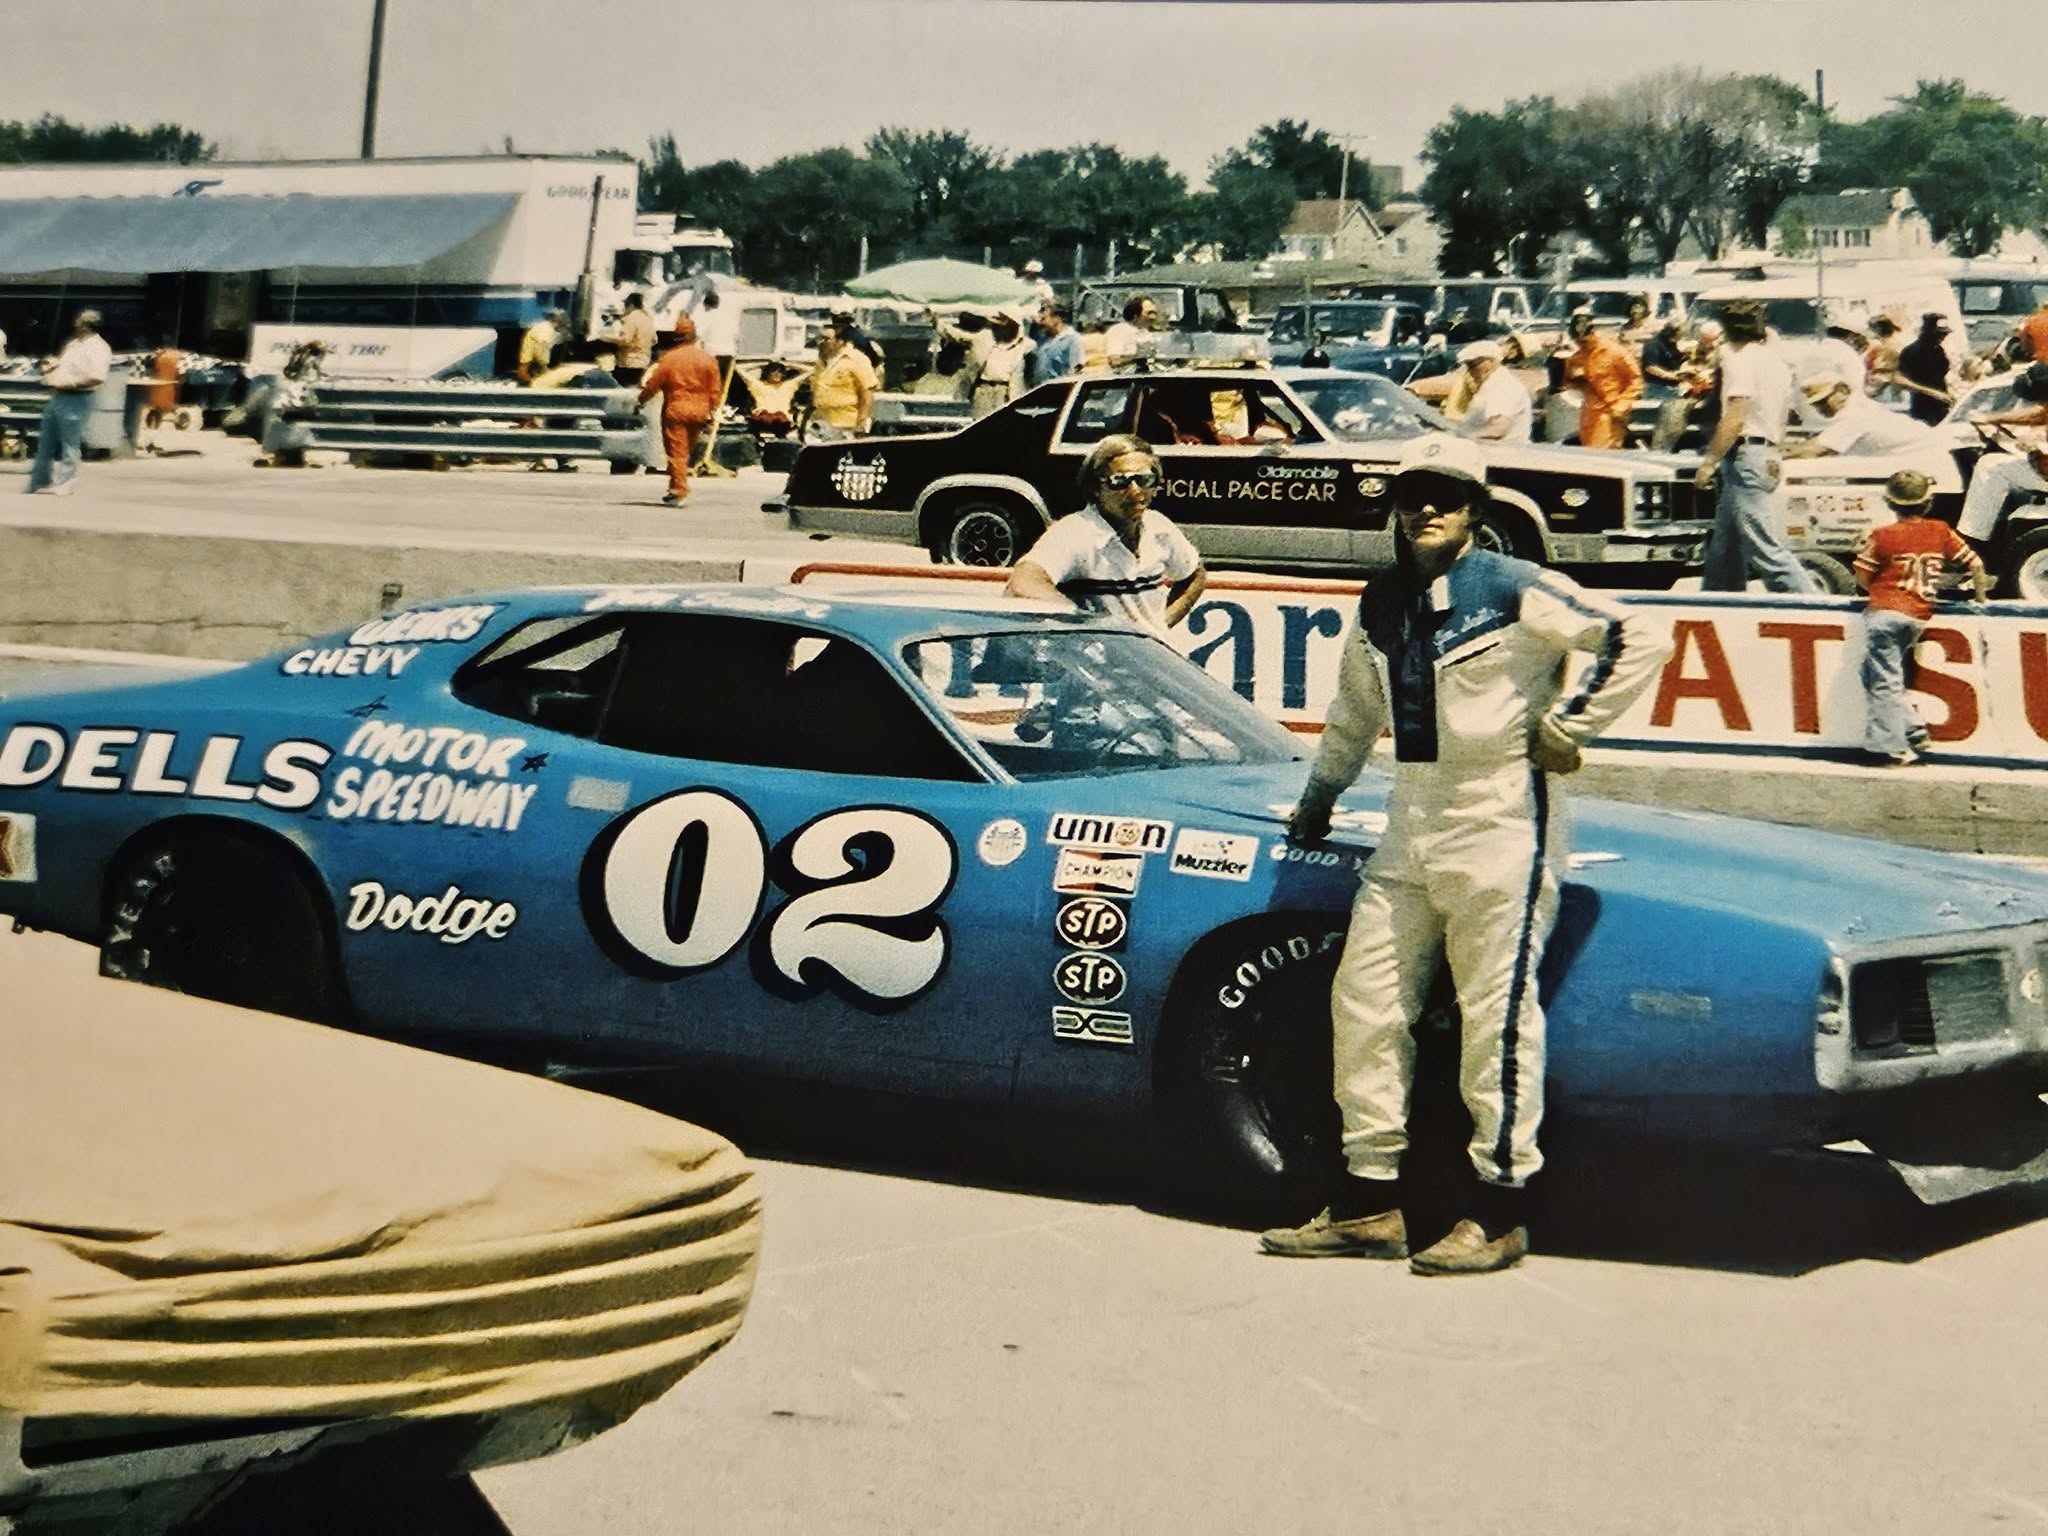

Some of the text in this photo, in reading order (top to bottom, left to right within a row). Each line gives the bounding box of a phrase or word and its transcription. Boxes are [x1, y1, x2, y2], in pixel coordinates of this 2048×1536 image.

[1153, 480, 1222, 499] FICIAL
[1228, 481, 1283, 500] PACE
[1288, 482, 1336, 501] CAR
[1257, 465, 1339, 479] Oldsmobile
[283, 648, 420, 676] CHEVY
[0, 724, 333, 809] DELLS
[345, 720, 526, 777] MOTOR
[327, 767, 538, 831] SPEEDWAY
[346, 882, 517, 943] Dodge
[598, 788, 953, 1003] 02
[1065, 902, 1117, 937] STP
[1064, 957, 1116, 992] STP
